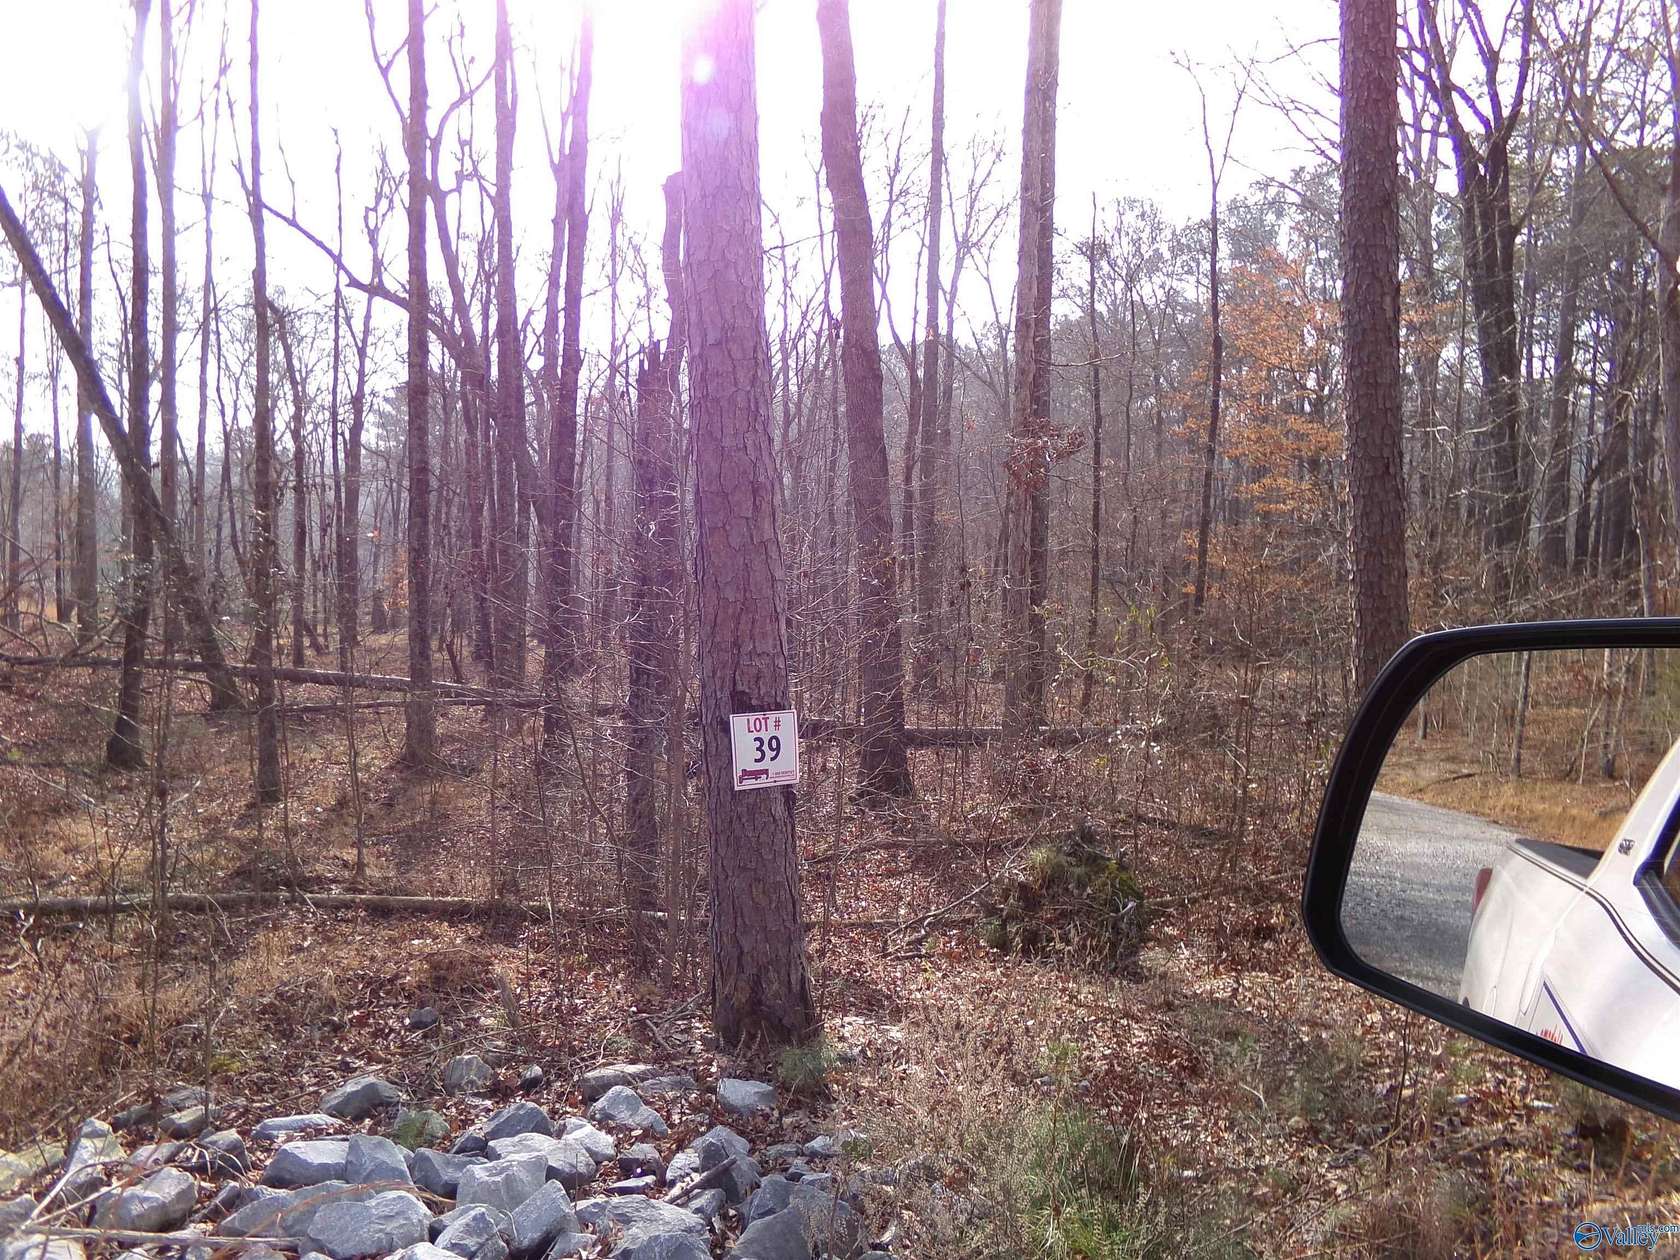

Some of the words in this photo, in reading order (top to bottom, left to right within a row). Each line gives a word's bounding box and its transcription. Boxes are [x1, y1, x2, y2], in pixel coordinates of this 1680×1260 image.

[747, 717, 769, 733] LOT
[774, 717, 781, 731] #
[753, 735, 781, 763] 39
